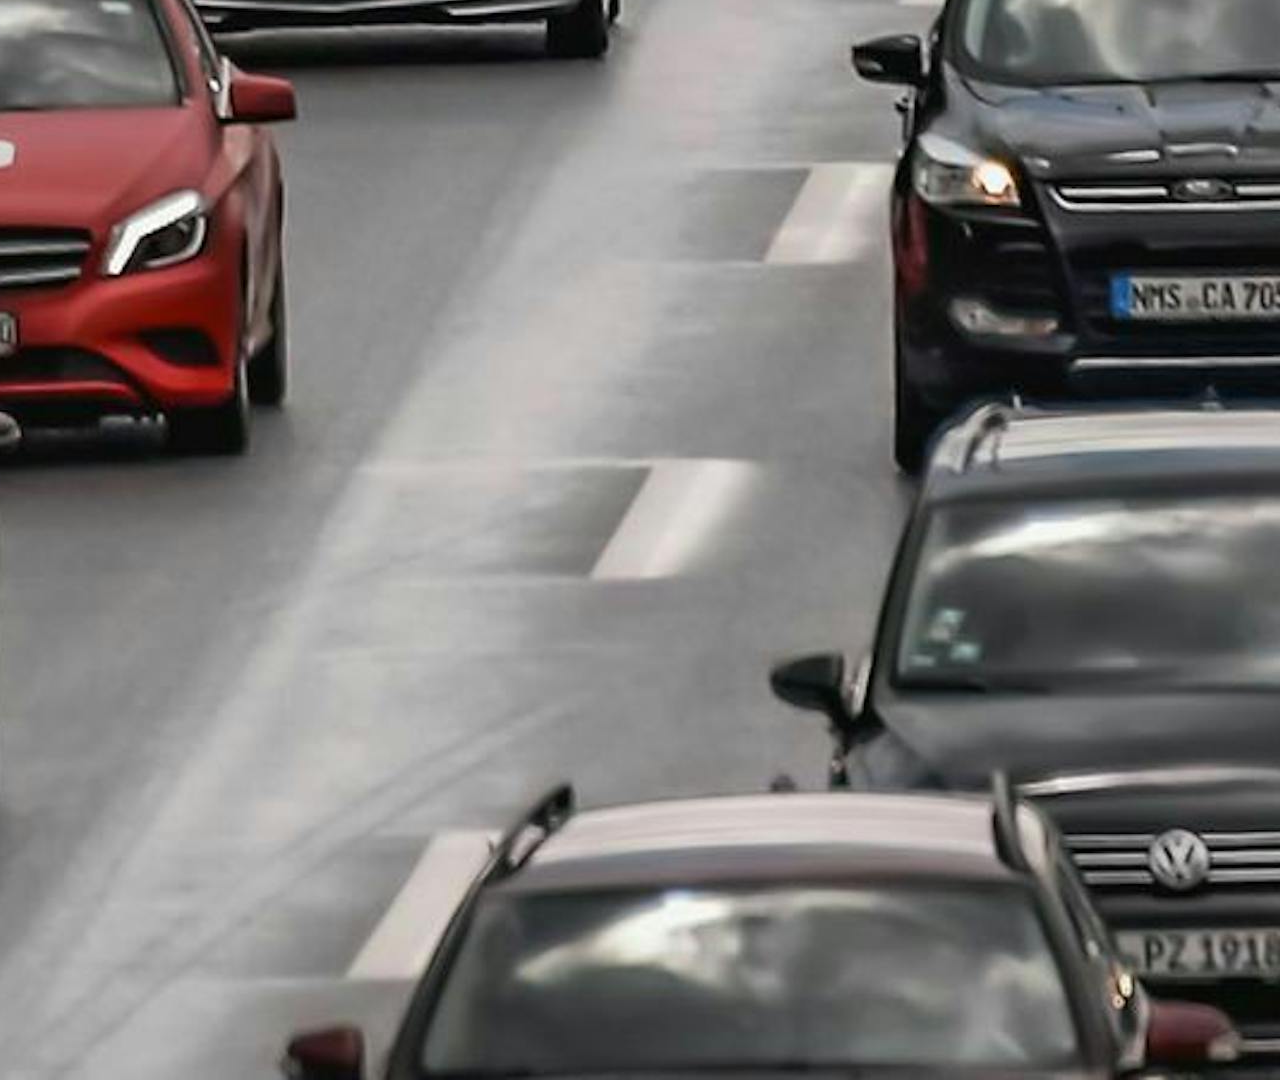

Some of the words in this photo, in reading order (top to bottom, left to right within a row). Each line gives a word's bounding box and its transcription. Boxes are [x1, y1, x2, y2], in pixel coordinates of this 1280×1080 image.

[1132, 282, 1182, 311] NMS
[1202, 281, 1236, 310] CA
[1143, 934, 1187, 970] PZ
